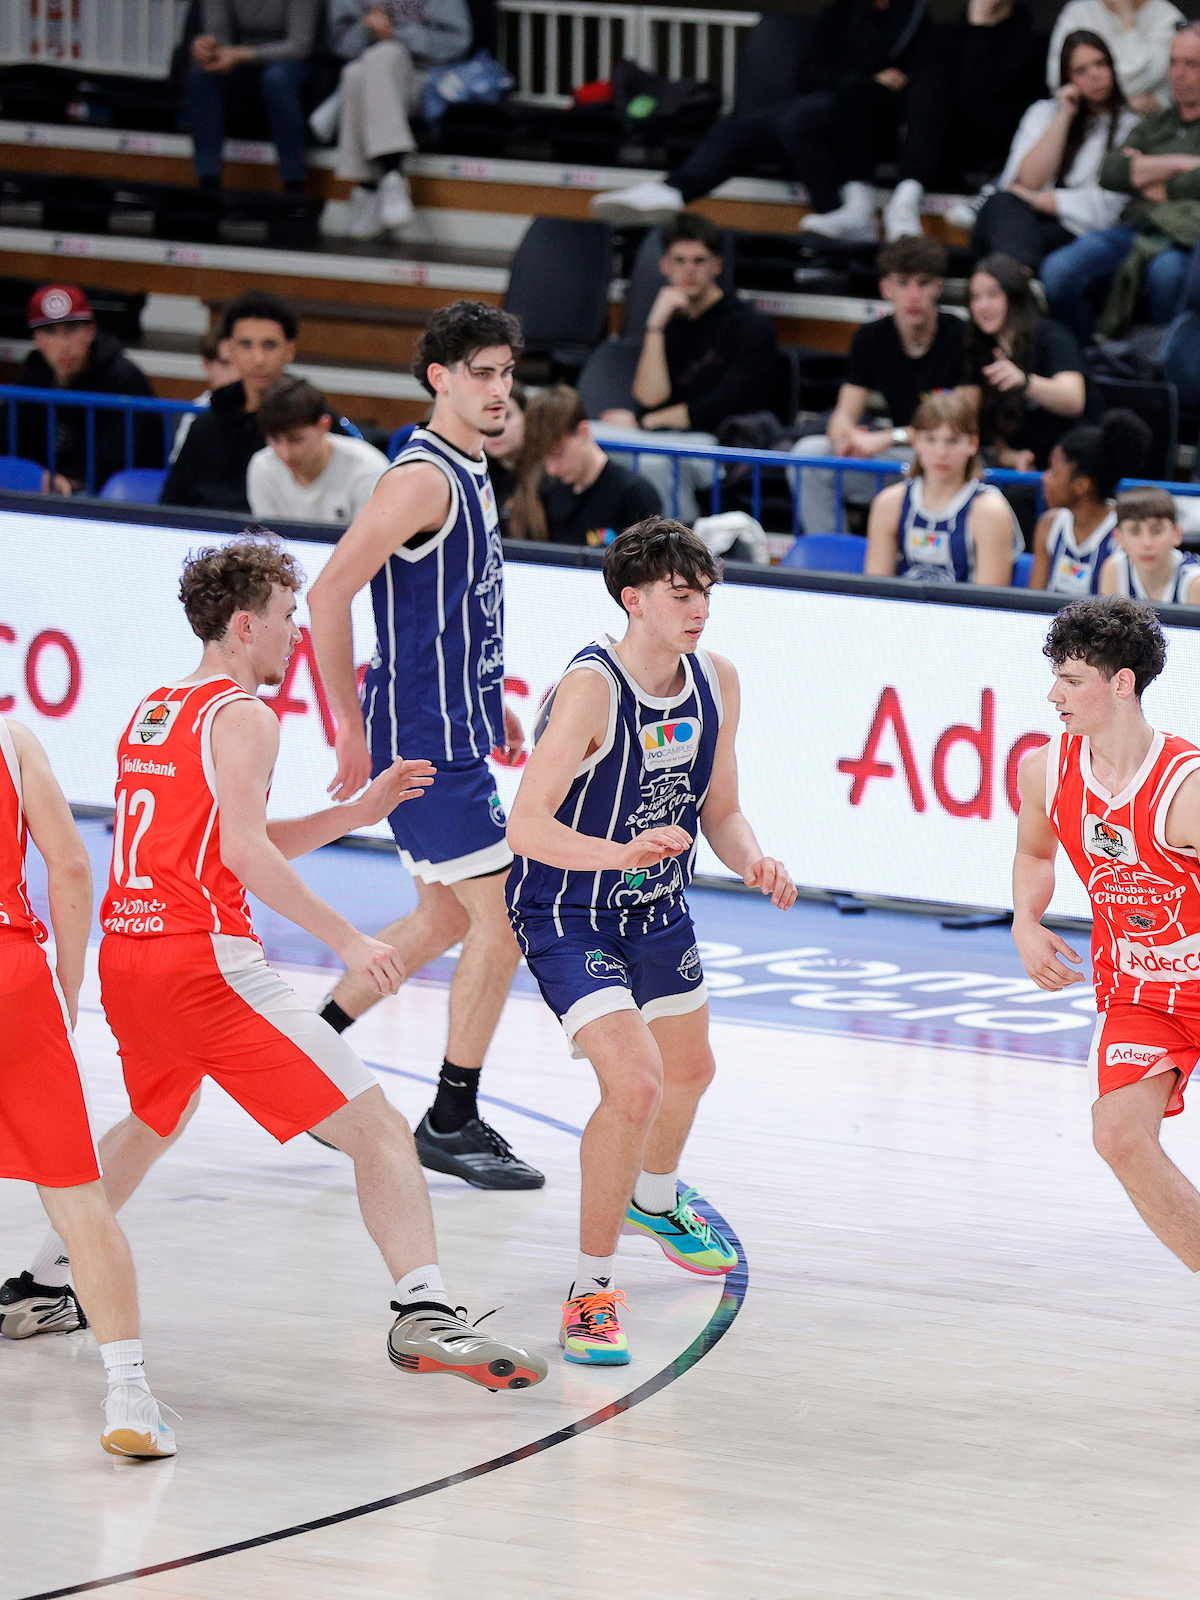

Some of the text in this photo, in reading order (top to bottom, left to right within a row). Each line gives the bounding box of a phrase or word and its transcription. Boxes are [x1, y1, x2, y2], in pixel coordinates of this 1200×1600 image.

[124, 757, 177, 778] Volksbank
[669, 792, 697, 811] CUP
[113, 789, 155, 889] 12
[1091, 885, 1187, 906] CHOOL CUP
[1102, 882, 1158, 895] Volksbank
